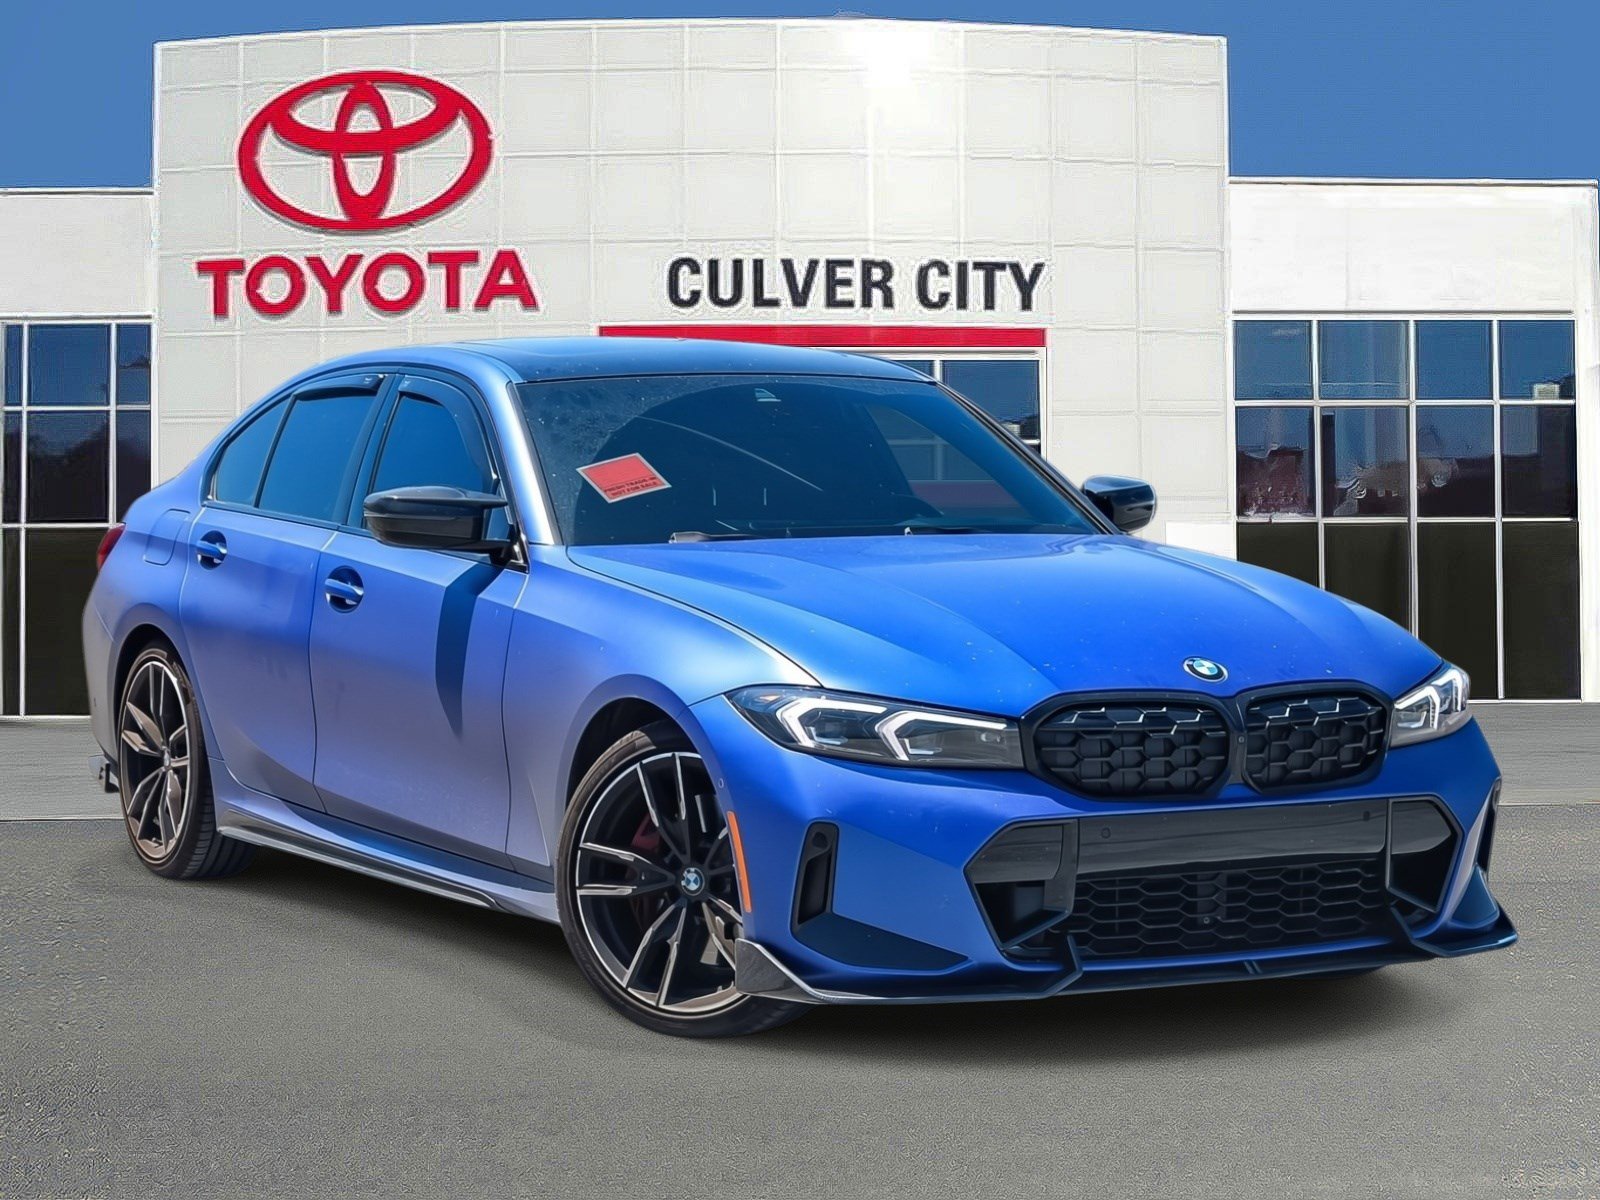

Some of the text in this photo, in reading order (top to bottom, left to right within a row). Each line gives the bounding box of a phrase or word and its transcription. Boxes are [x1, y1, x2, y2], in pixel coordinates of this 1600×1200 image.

[195, 250, 539, 317] TOYOTA
[667, 257, 1045, 311] CULVER CITY
